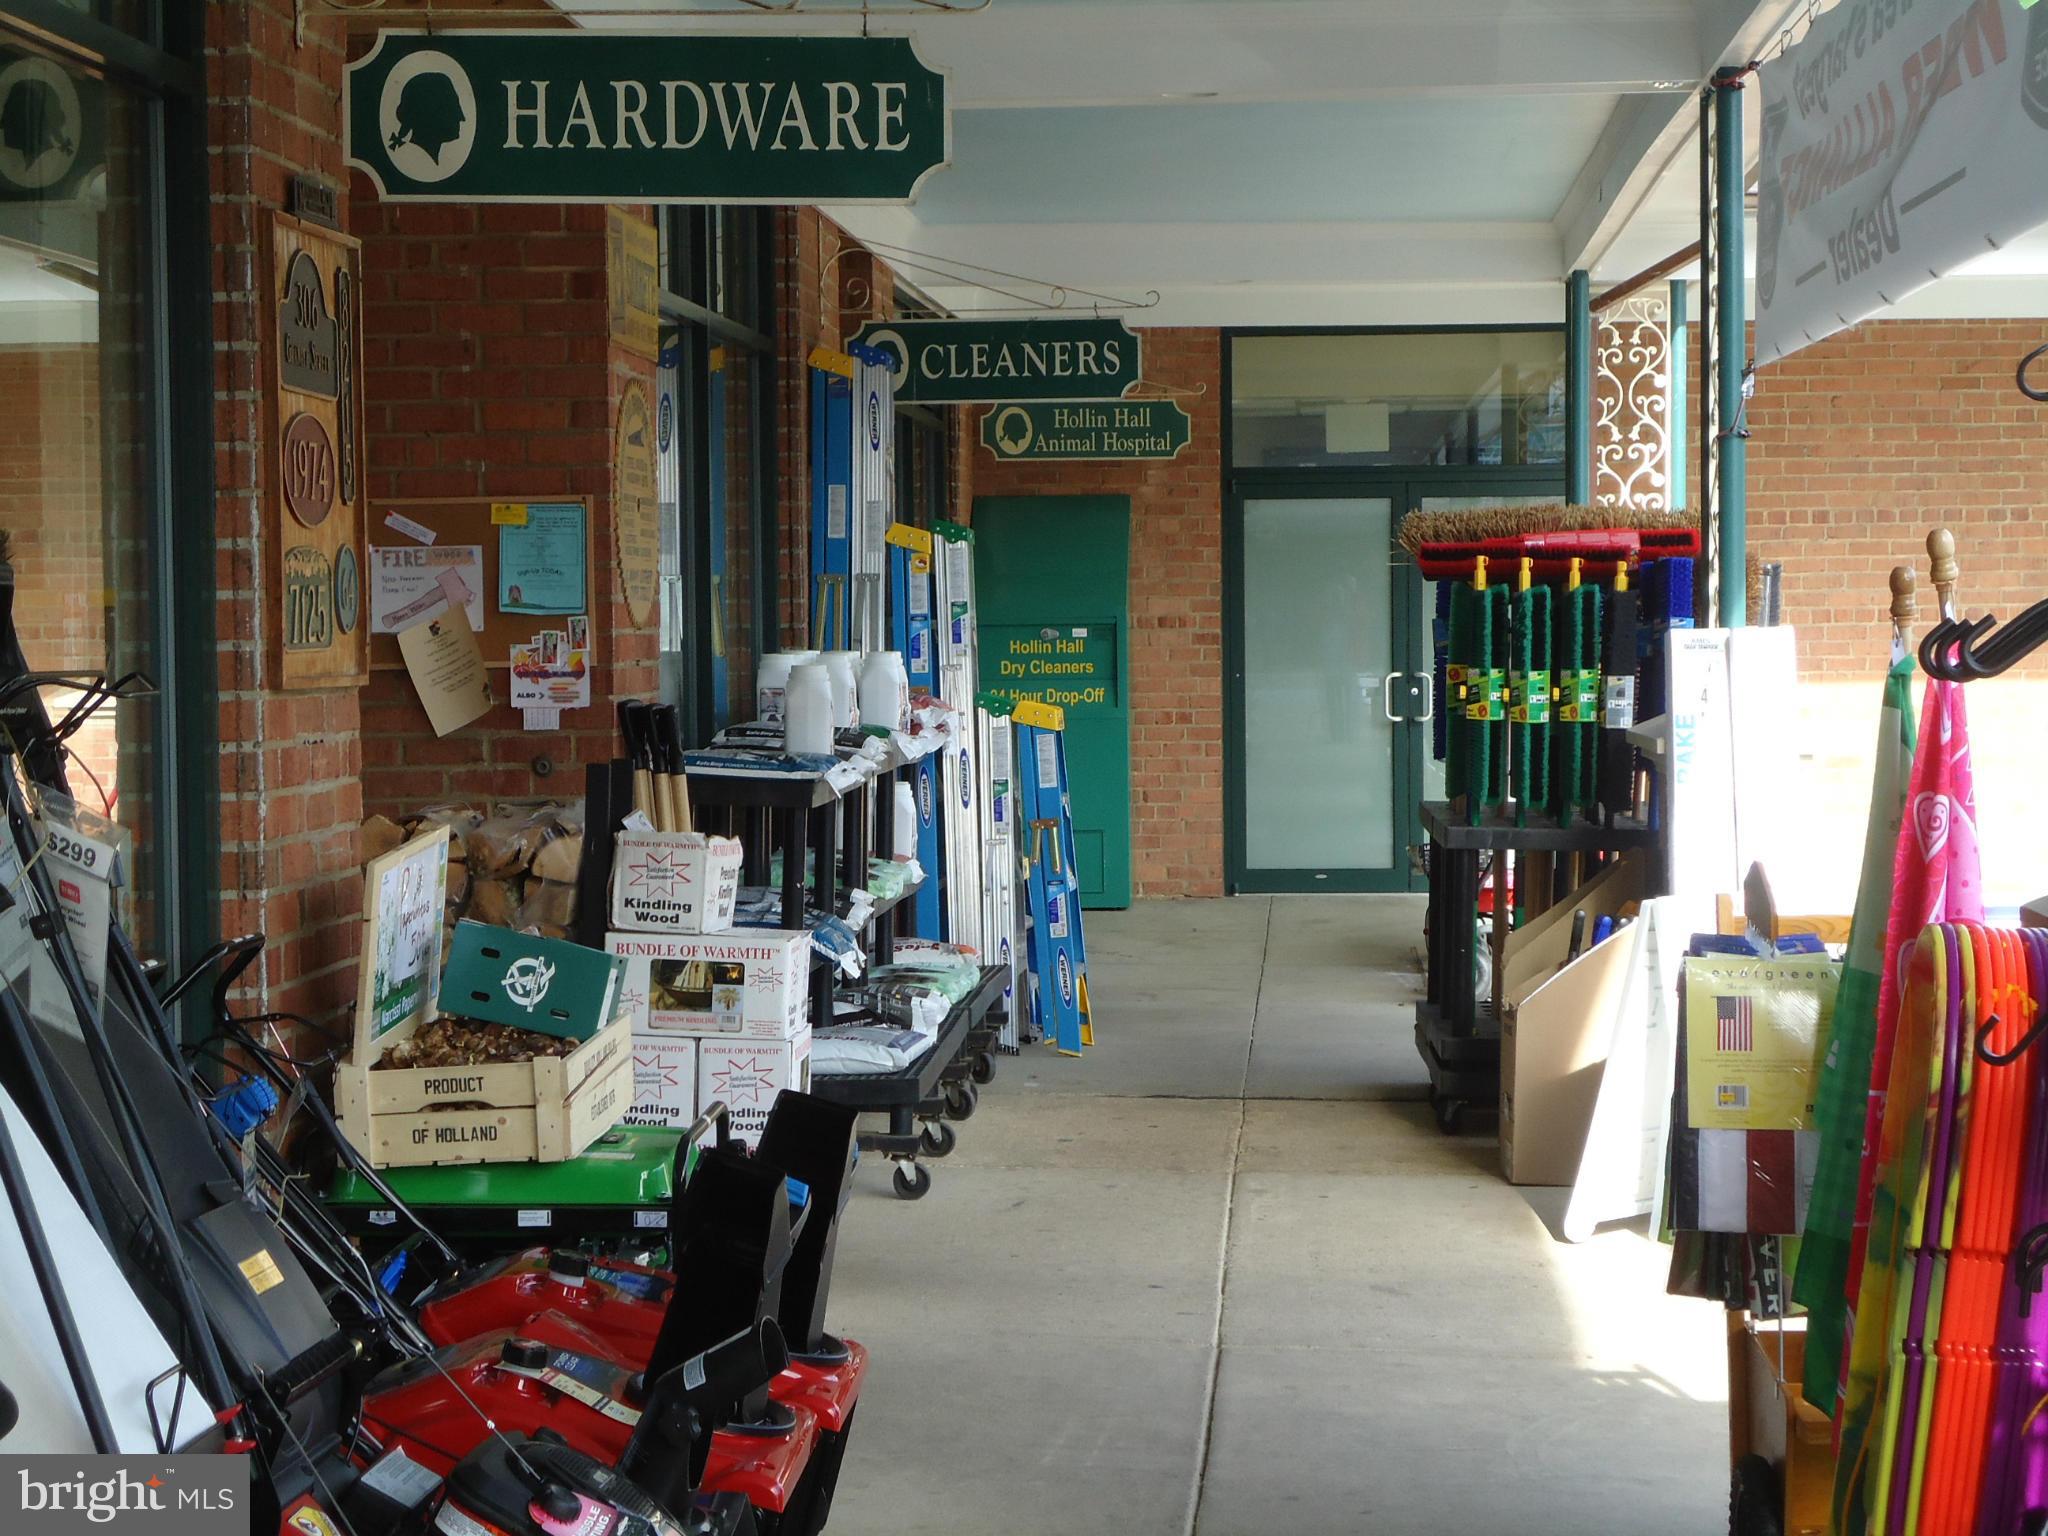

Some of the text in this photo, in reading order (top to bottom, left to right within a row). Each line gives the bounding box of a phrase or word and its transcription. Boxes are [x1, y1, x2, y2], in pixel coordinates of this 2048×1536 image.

[501, 80, 911, 152] HARDWARE
[295, 281, 319, 332] 306
[920, 340, 1121, 380] CLEANERS
[870, 401, 879, 441] WERNER
[1053, 407, 1152, 429] Hollin Hall
[1035, 431, 1171, 455] Animal Hospital
[291, 438, 329, 503] 1974
[381, 549, 426, 569] FIRE
[290, 584, 326, 644] 7125
[1009, 639, 1084, 654] Hollin Hall
[1000, 660, 1094, 678] Dry Cleaners
[1009, 688, 1043, 702] Hour
[1046, 688, 1105, 706] Drop-Off
[961, 757, 969, 802] WERNER
[920, 775, 930, 820] WERNER
[47, 830, 97, 868] $299
[623, 839, 651, 848] BUNDLE
[624, 897, 692, 914] Kindling
[635, 911, 680, 924] Wood
[616, 942, 676, 958] BUNDLE
[679, 944, 699, 958] OF
[1058, 957, 1070, 999] WERNER
[734, 1047, 745, 1055] OF
[424, 1076, 485, 1096] PRODUCT
[625, 1104, 680, 1118] ndling
[412, 1125, 498, 1146] OF HOLLAND
